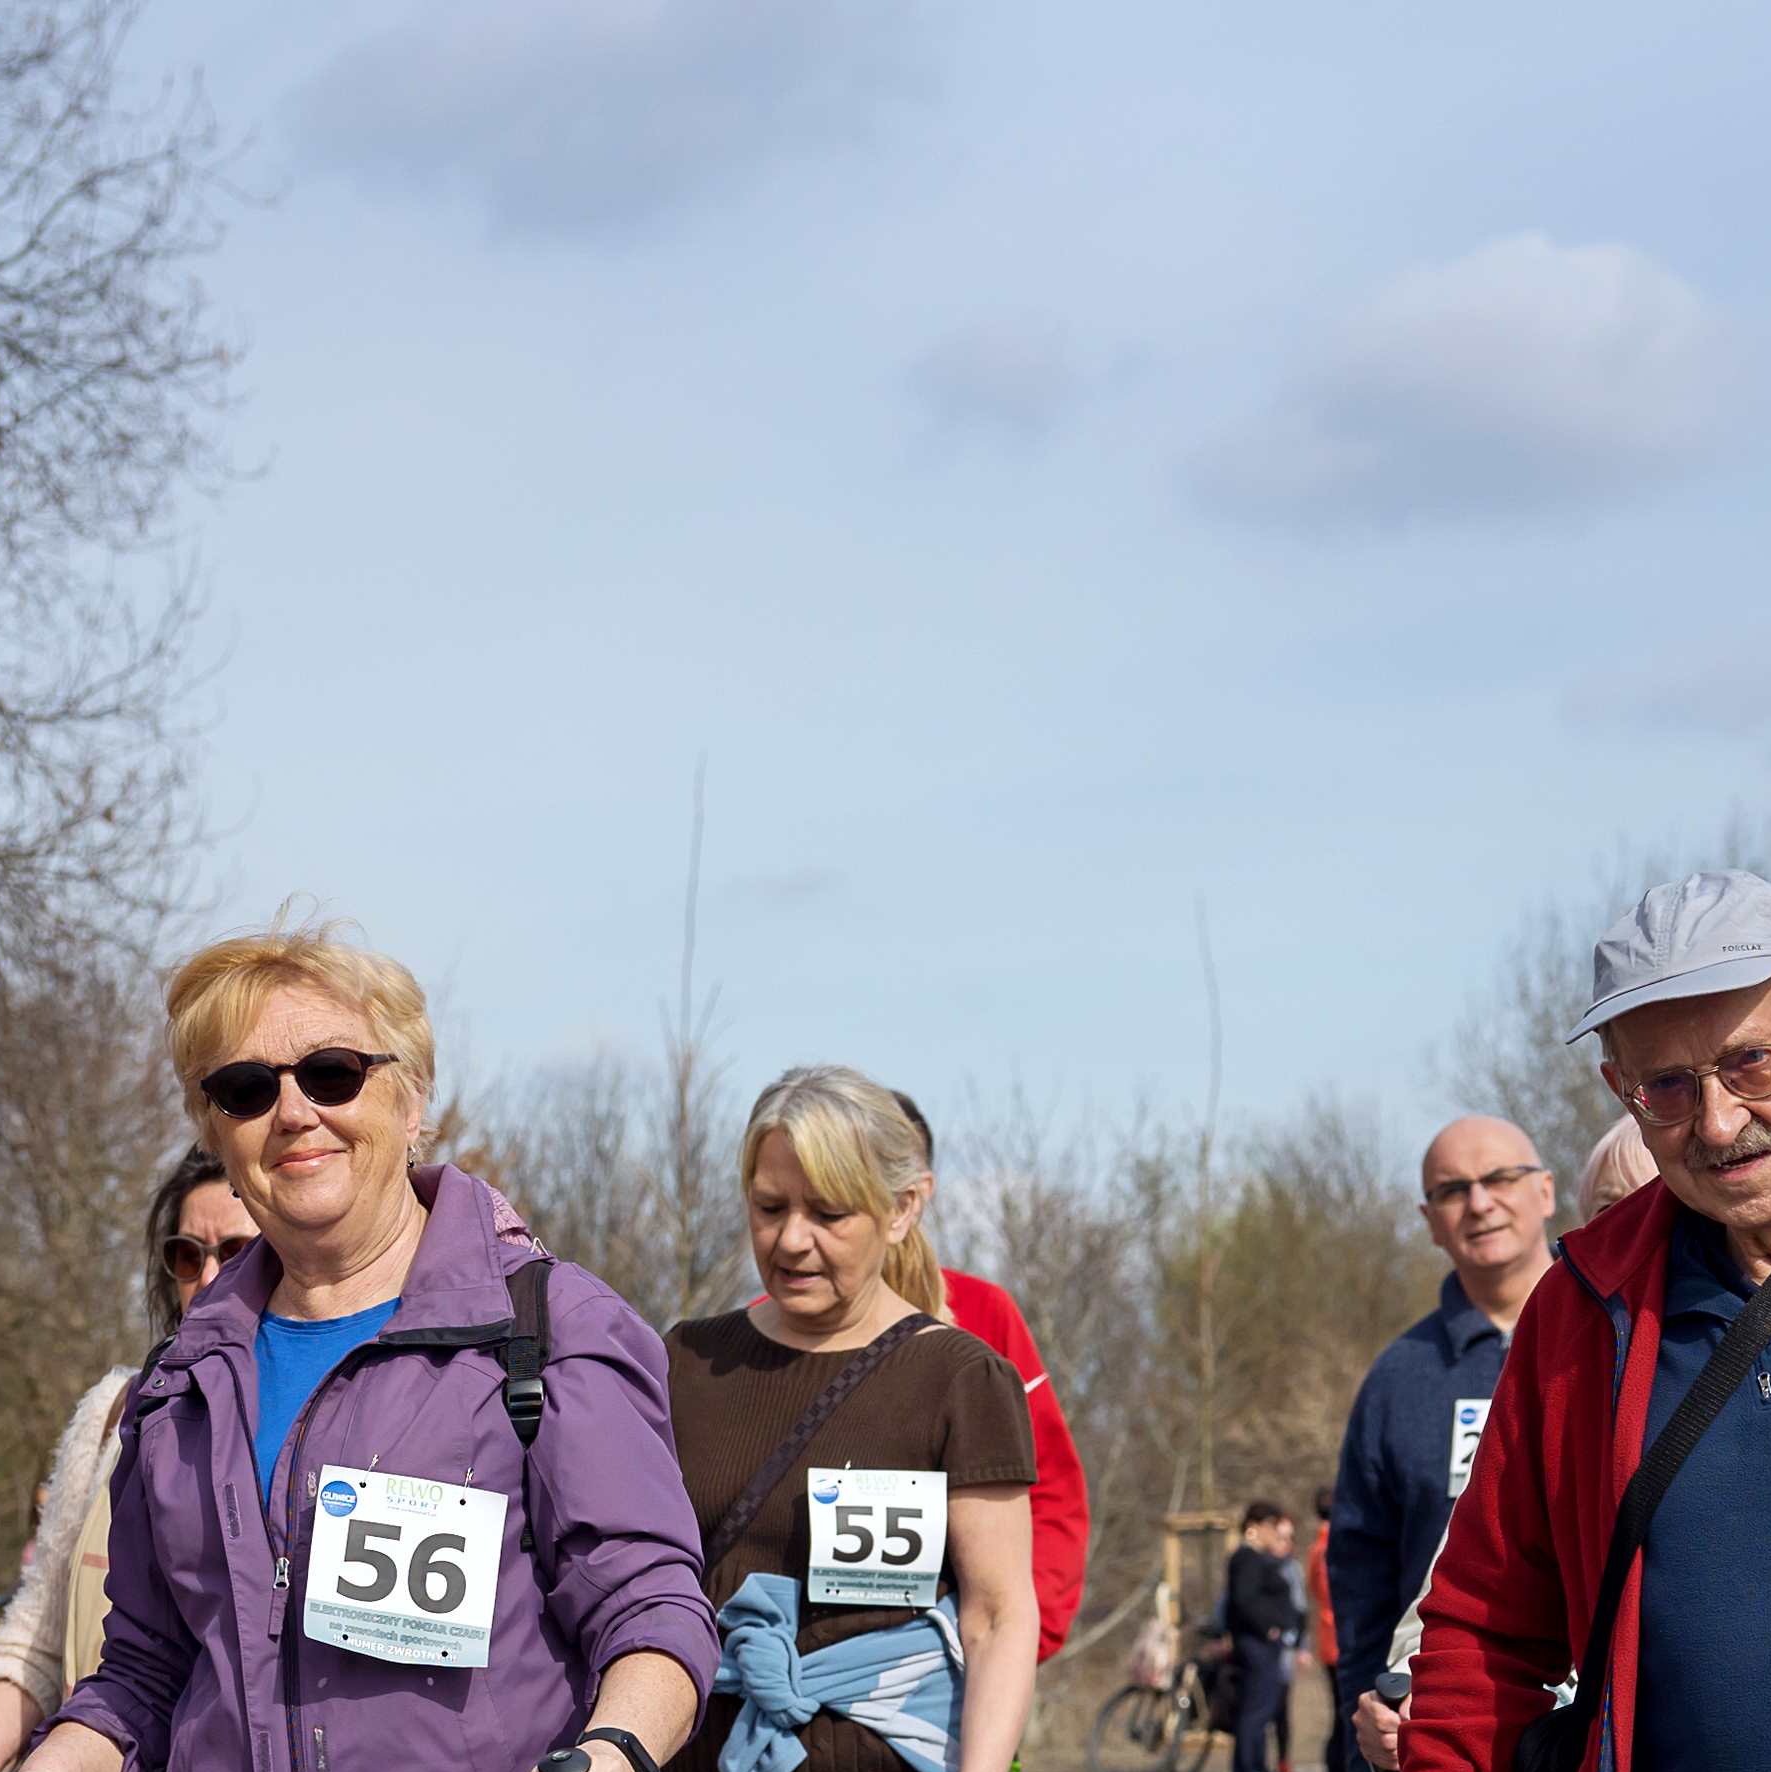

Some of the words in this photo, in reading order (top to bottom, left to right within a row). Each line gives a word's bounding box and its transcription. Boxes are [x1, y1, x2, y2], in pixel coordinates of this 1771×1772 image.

[1461, 1431, 1480, 1464] 2
[386, 1477, 443, 1502] REWO
[386, 1495, 439, 1510] SPORT
[832, 1506, 924, 1567] 55
[335, 1518, 468, 1615] 56
[309, 1601, 402, 1627] ELEKTRONICZNY
[402, 1617, 448, 1636] POMIAR
[449, 1626, 487, 1641] CZASU
[329, 1621, 343, 1631] na
[345, 1623, 398, 1642] zawodach
[348, 1636, 385, 1653] NUMER
[387, 1644, 442, 1662] ZWROTNY
